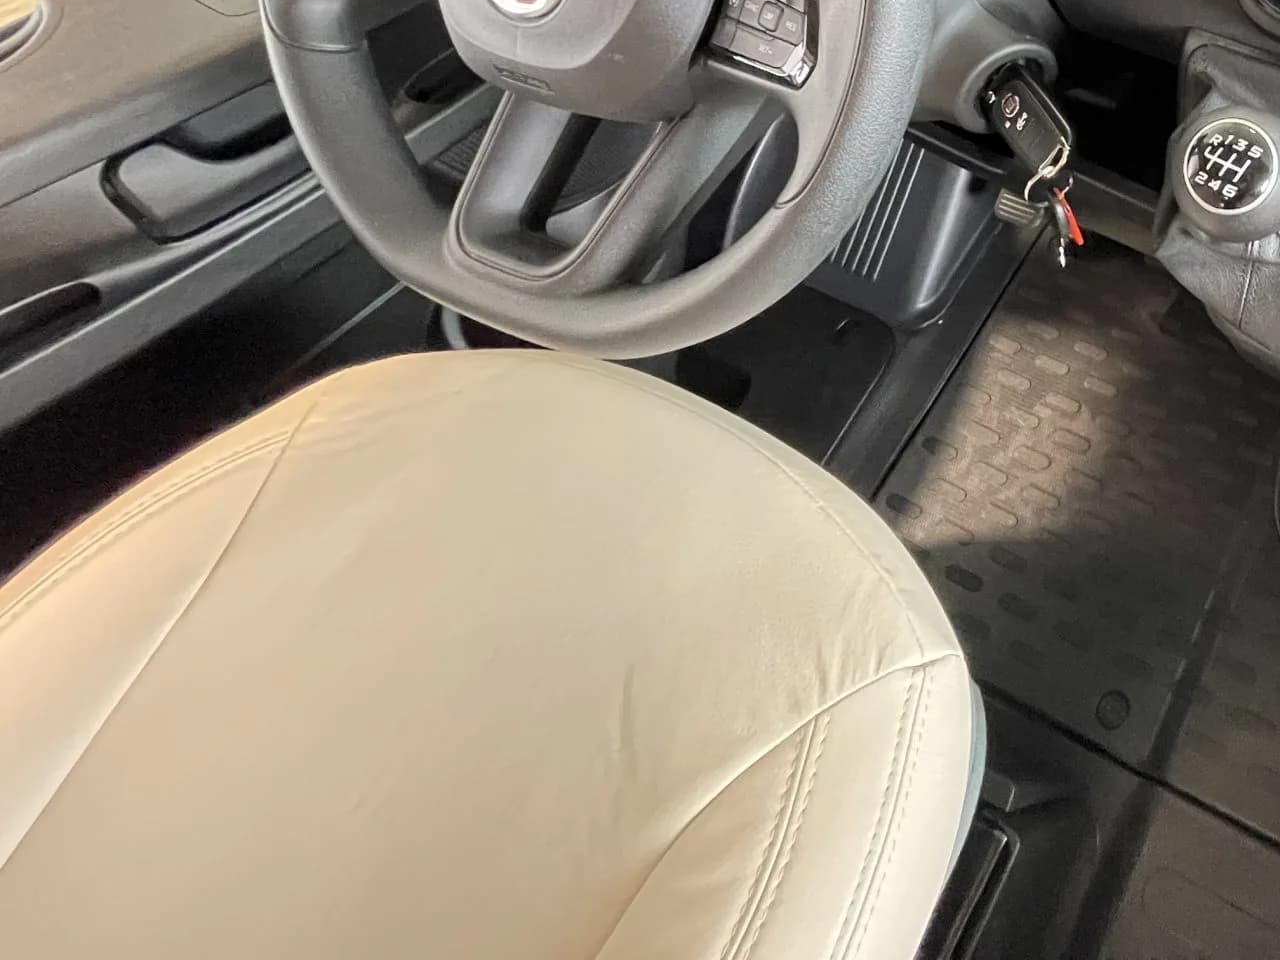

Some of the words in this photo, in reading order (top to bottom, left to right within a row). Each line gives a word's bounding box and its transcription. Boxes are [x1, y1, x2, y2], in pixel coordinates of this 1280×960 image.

[1208, 133, 1223, 146] R
[1224, 134, 1235, 145] 1
[1232, 138, 1249, 152] 3
[1247, 145, 1264, 159] 5
[1194, 171, 1209, 185] 2
[1207, 178, 1222, 191] 4
[1222, 184, 1239, 198] 6
